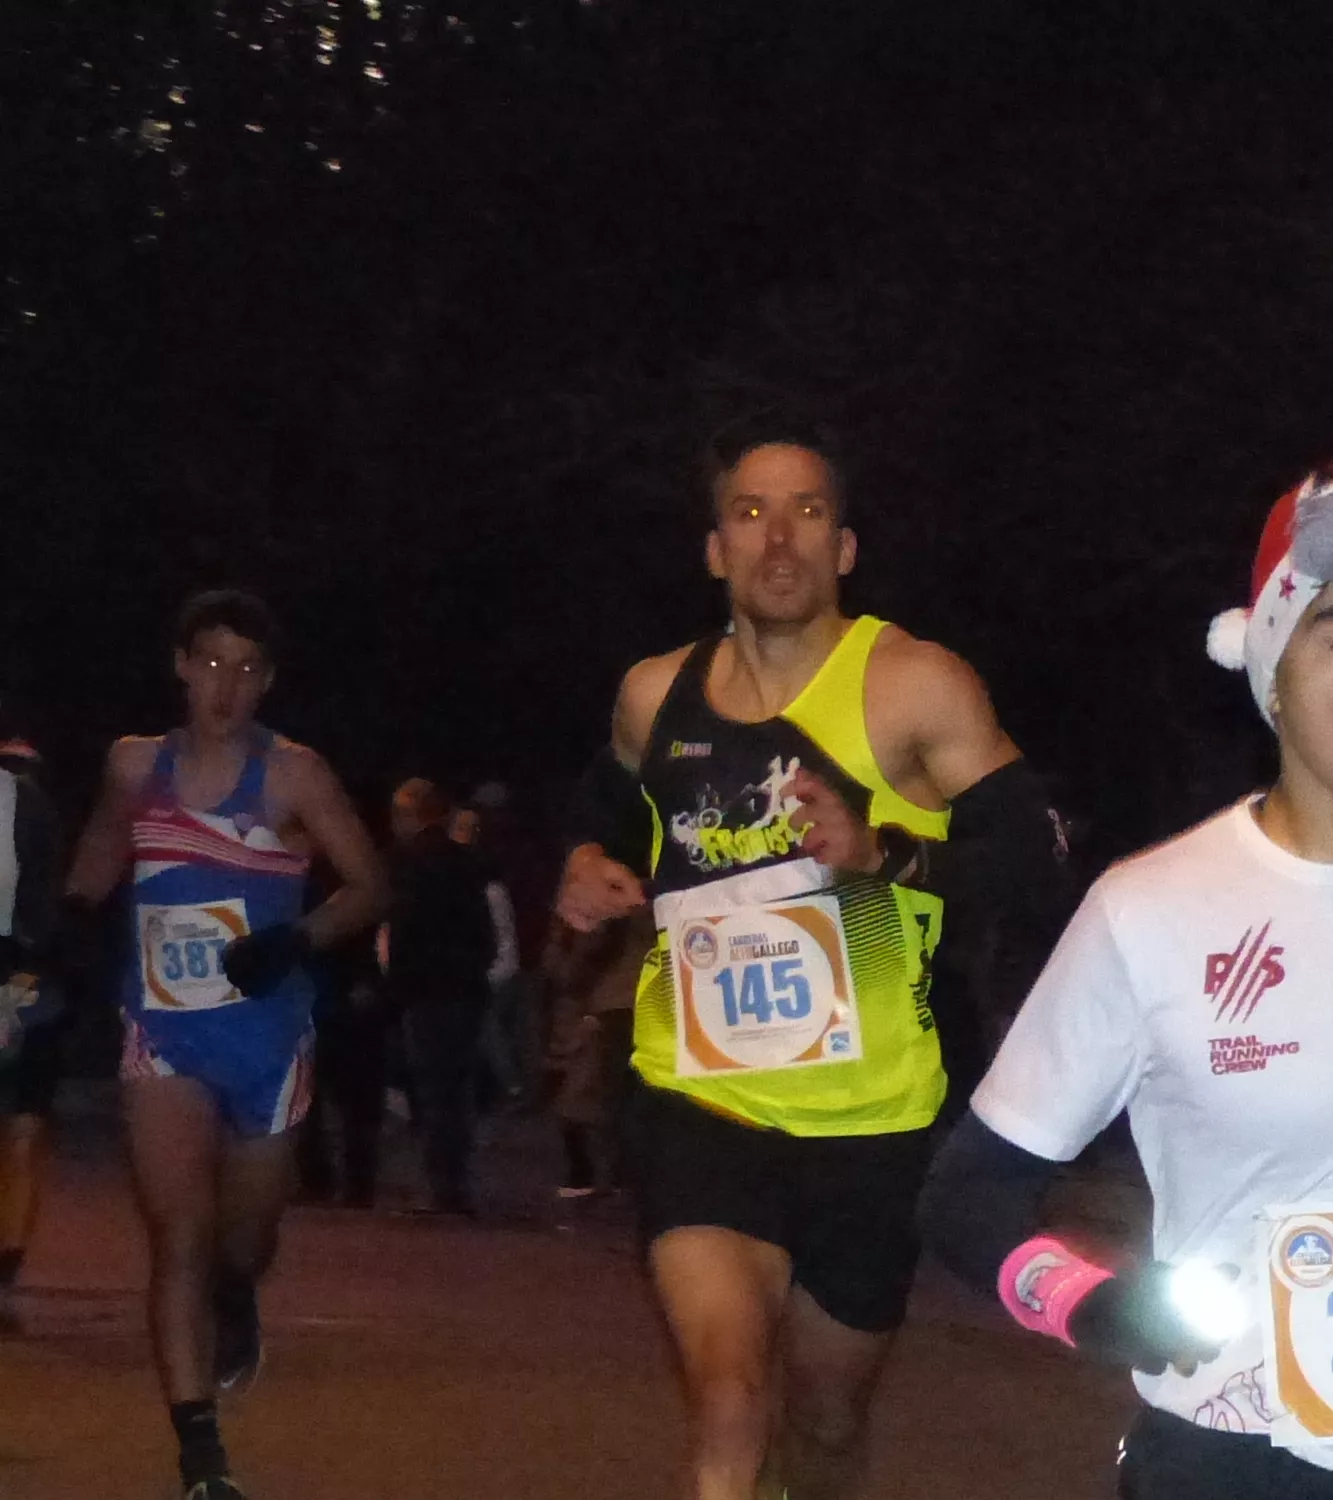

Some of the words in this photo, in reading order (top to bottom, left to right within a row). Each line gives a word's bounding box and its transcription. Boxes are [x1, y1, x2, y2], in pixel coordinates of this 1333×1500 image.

[713, 958, 812, 1026] 145
[1208, 1035, 1262, 1049] TRAIL
[1210, 1042, 1299, 1063] RUNNING
[1212, 1059, 1266, 1075] CREW
